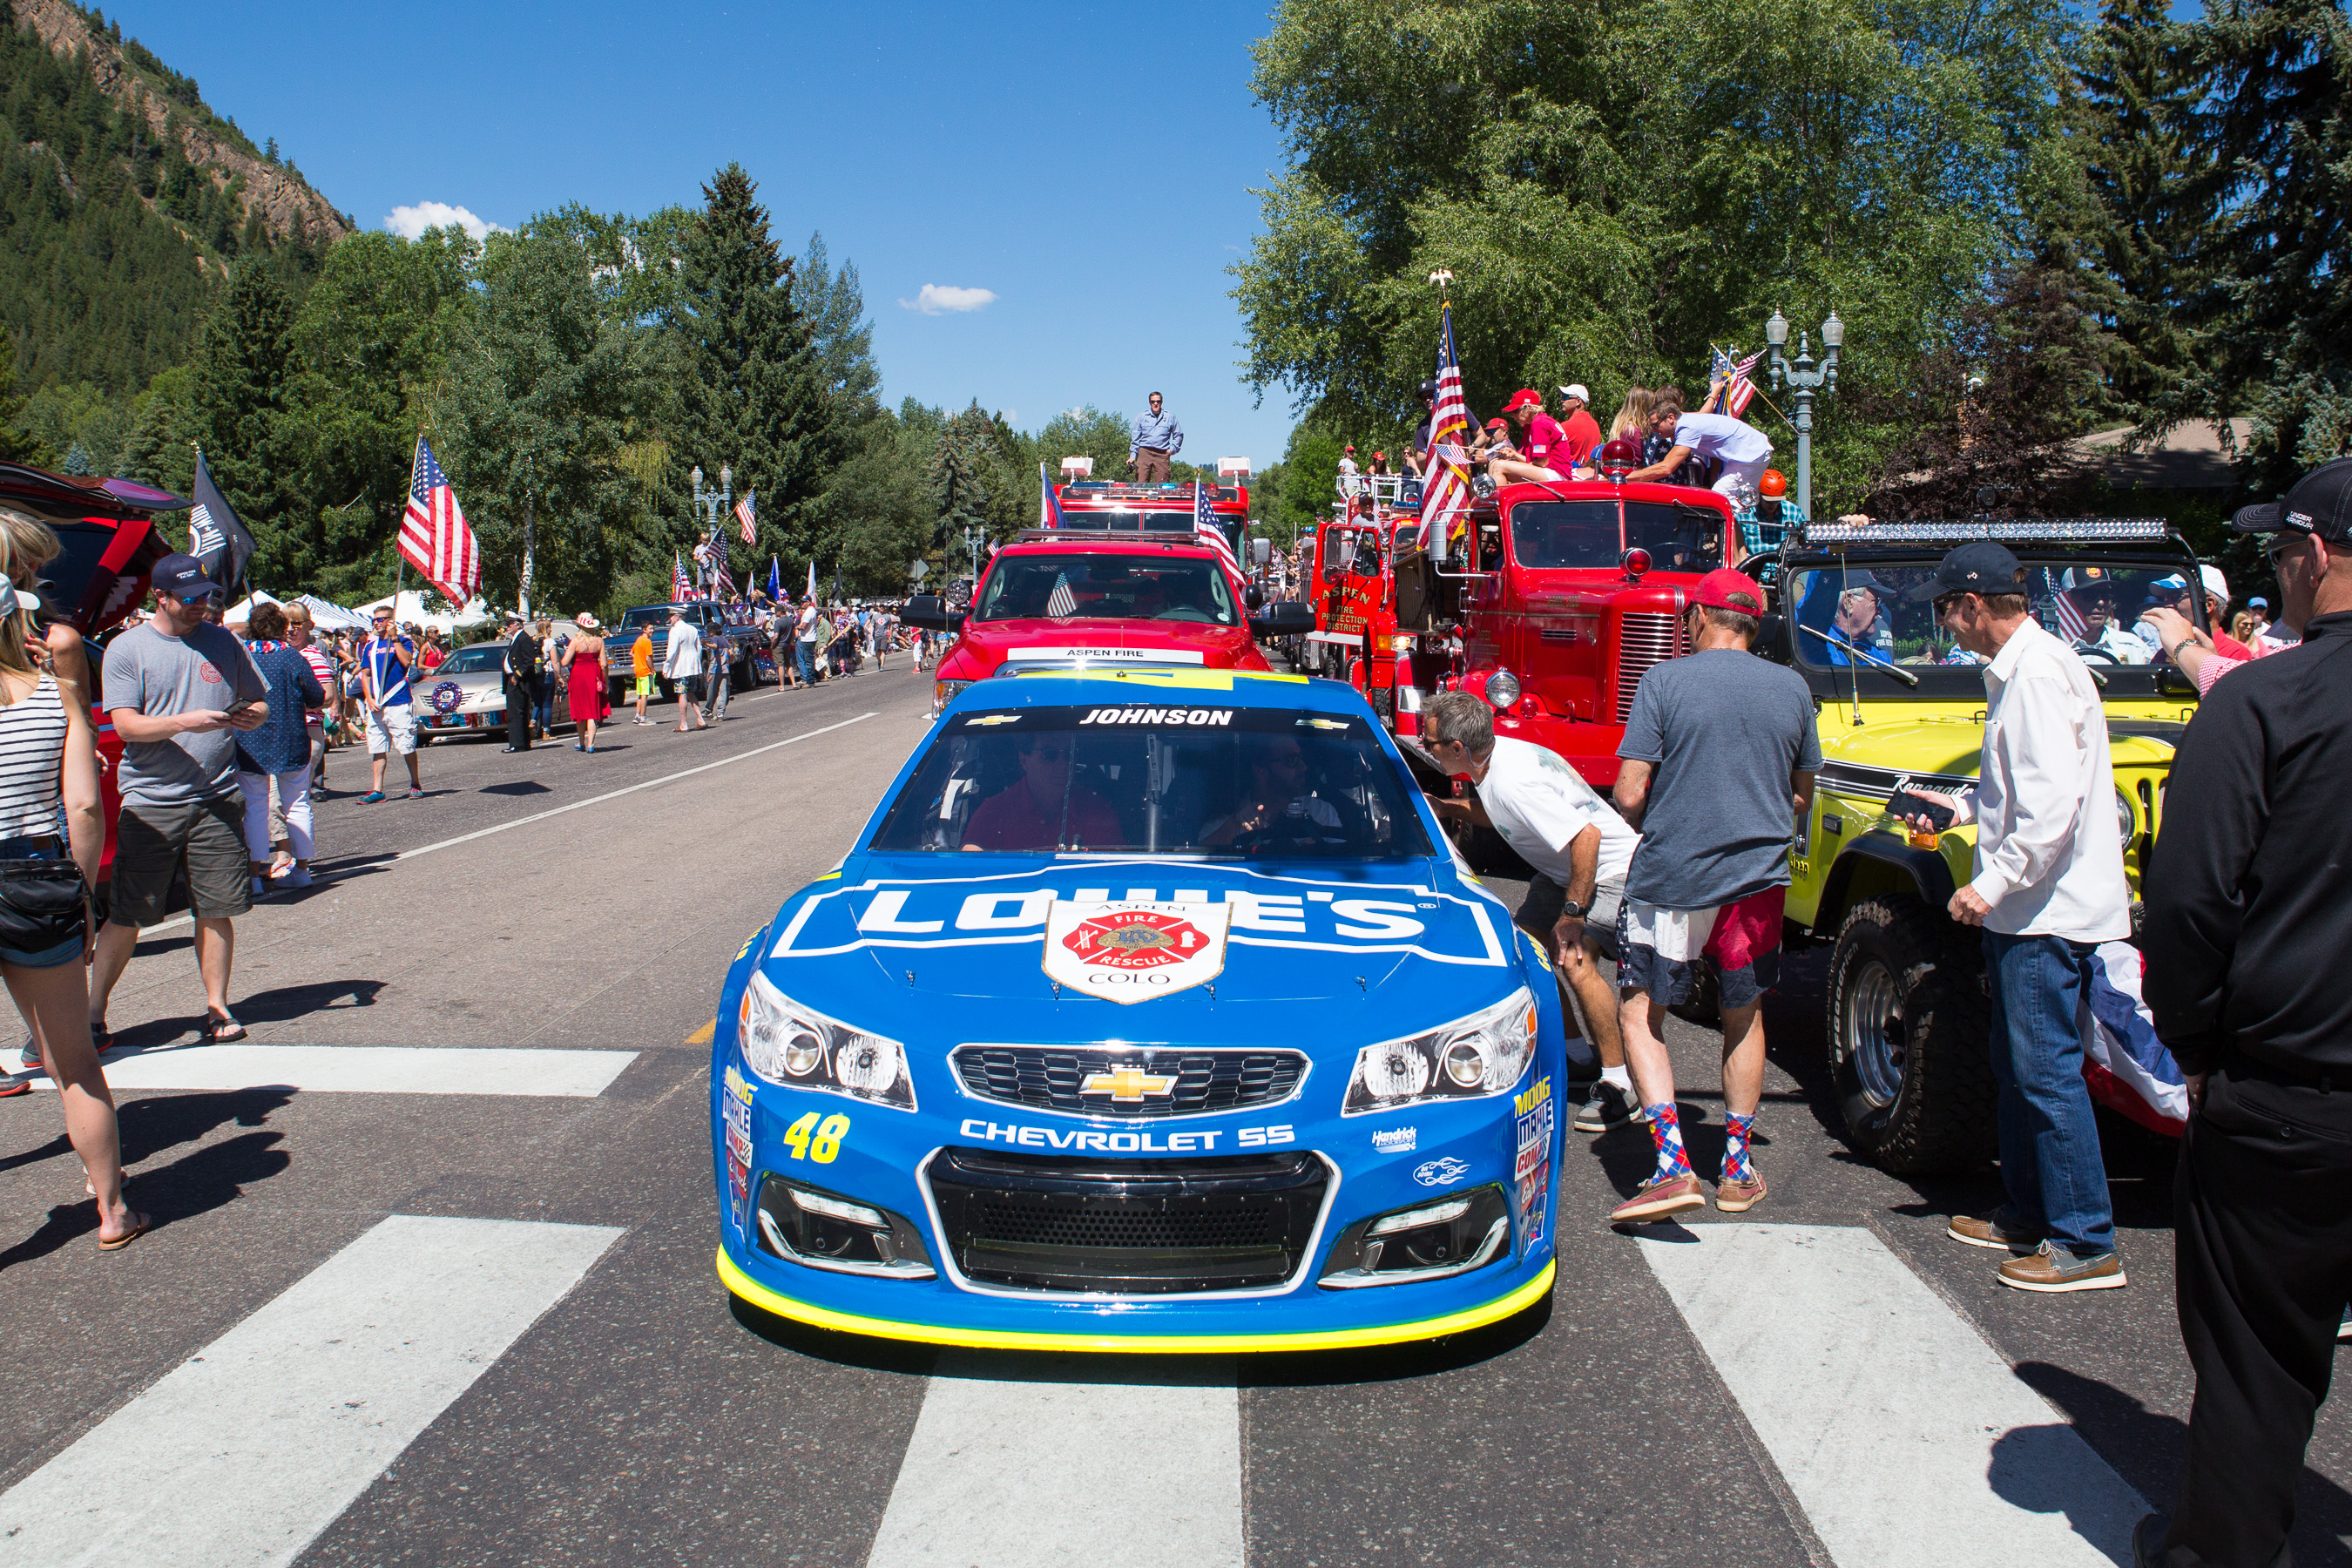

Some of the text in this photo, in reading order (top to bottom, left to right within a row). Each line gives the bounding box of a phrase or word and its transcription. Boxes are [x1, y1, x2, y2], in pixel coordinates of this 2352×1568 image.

[2286, 516, 2314, 530] ARMOUR
[2289, 510, 2313, 523] UNDER
[196, 528, 226, 558] MIA
[1321, 586, 1370, 605] ASPEN
[1321, 612, 1369, 625] PROTECTION
[1335, 605, 1355, 614] FIRE
[1326, 622, 1362, 633] DISTRICT
[1078, 708, 1233, 726] JOHNSON
[1096, 902, 1186, 911] ASPEN
[1113, 915, 1159, 923] FIRE
[1098, 955, 1171, 966] RESCUE
[1089, 973, 1171, 984] COLO
[724, 1065, 759, 1106] MOOG
[1514, 1076, 1551, 1119] MOOG
[724, 1092, 751, 1135] MAHLE
[1518, 1101, 1552, 1146] MAHLE
[783, 1111, 851, 1164] 48
[960, 1119, 1295, 1152] CHEVROLET SS
[1371, 1125, 1417, 1147] Hendrick
